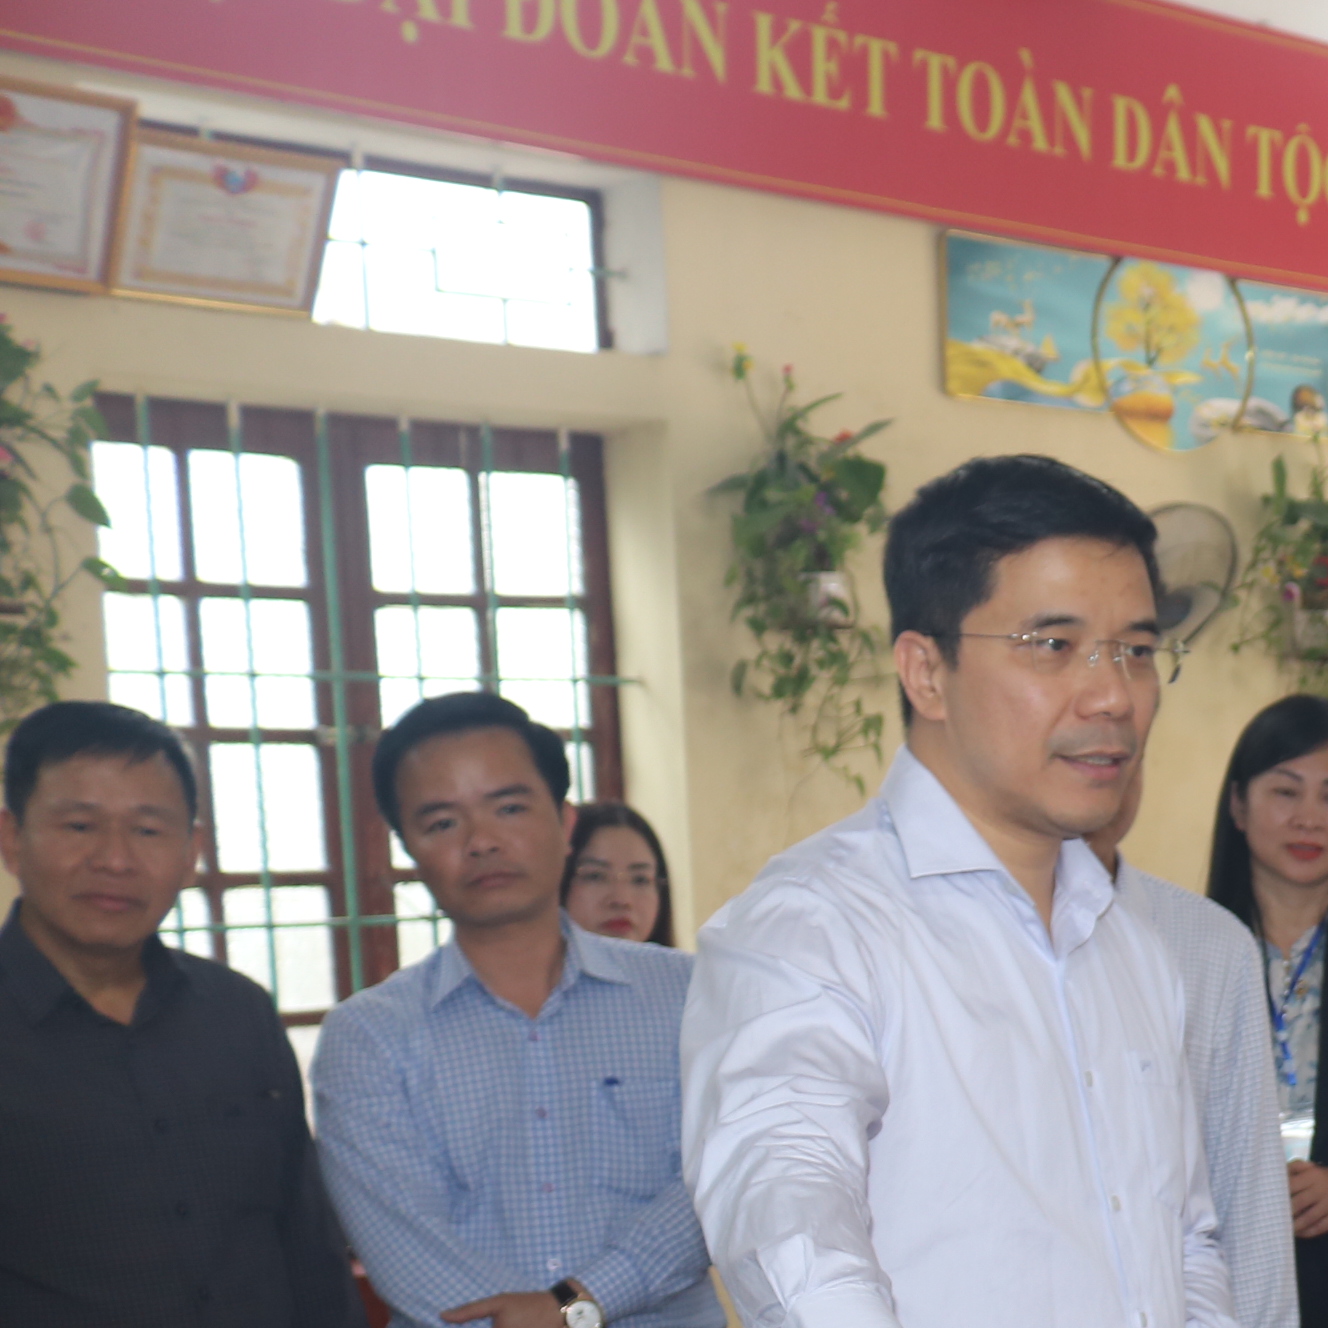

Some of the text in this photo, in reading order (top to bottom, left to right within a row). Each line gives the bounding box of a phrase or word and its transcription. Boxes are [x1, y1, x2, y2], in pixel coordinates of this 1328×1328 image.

[752, 0, 901, 120] KẾT
[911, 46, 1096, 164] TOÀN
[1111, 81, 1234, 192] DÂN
